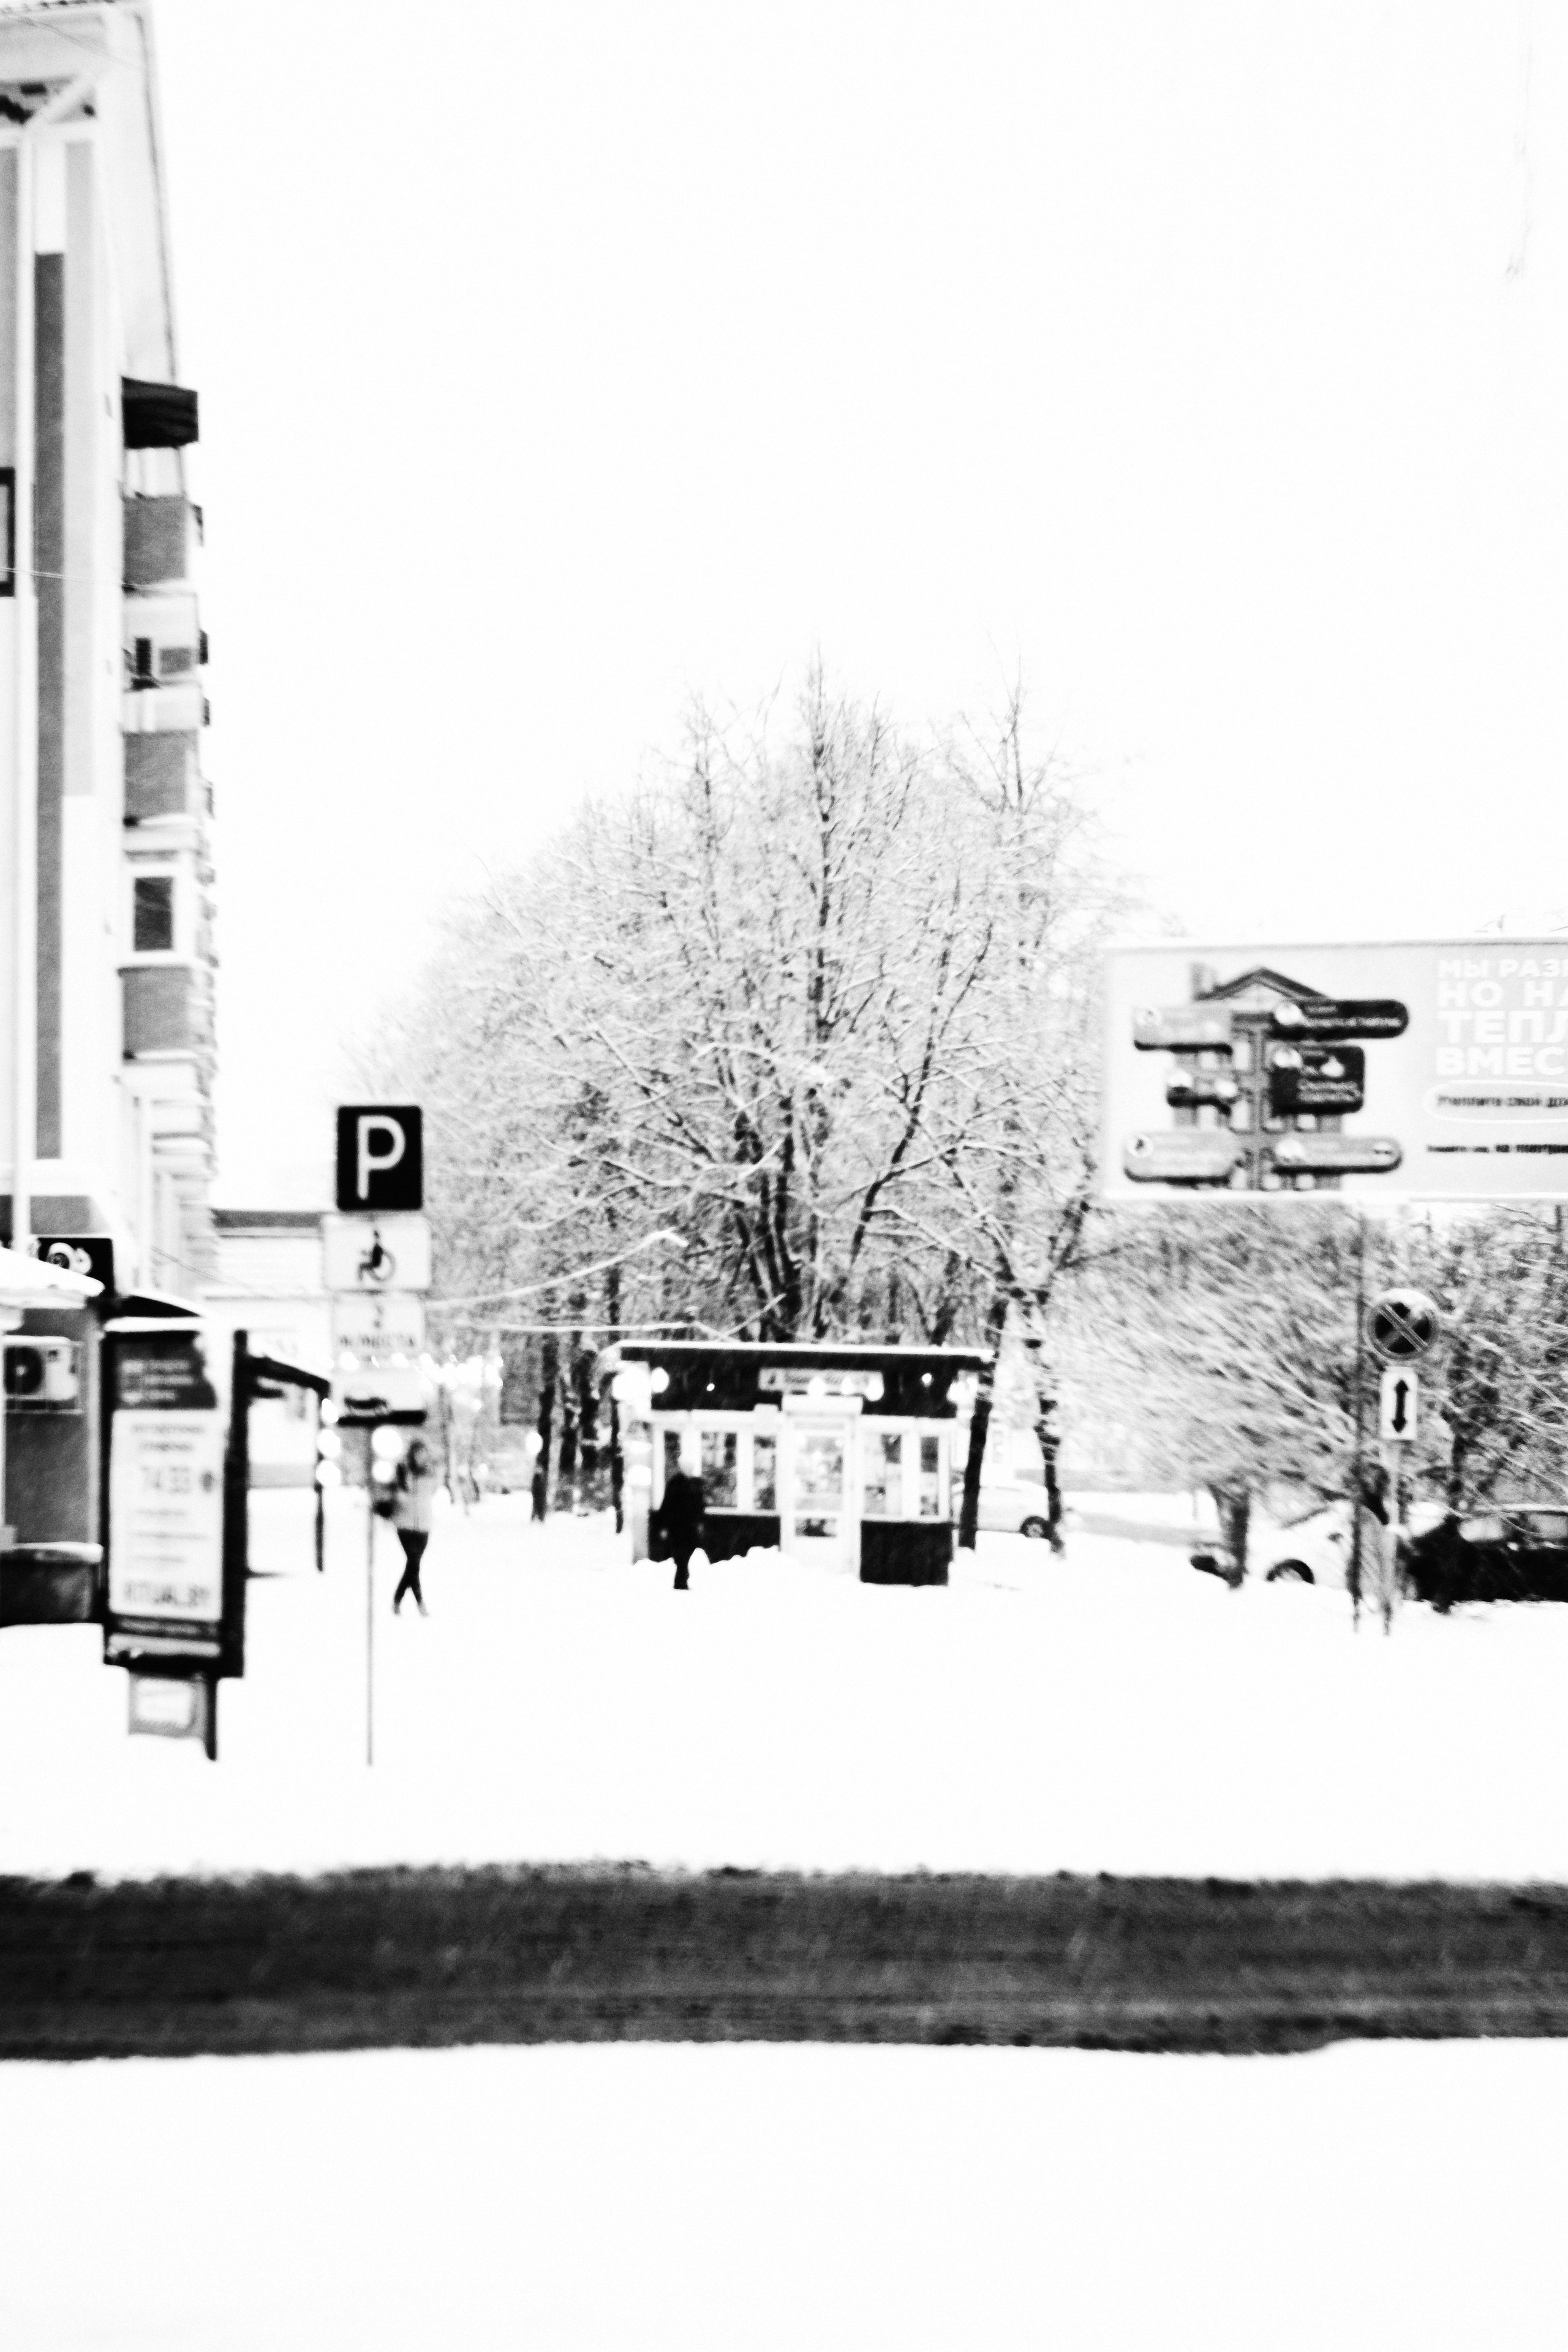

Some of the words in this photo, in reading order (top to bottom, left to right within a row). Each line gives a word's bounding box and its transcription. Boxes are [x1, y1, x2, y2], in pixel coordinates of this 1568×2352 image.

[1438, 959, 1490, 979] МЫ
[1438, 980, 1504, 1008] НО
[1436, 1046, 1567, 1076] ВМЕС
[356, 1114, 407, 1200] P
